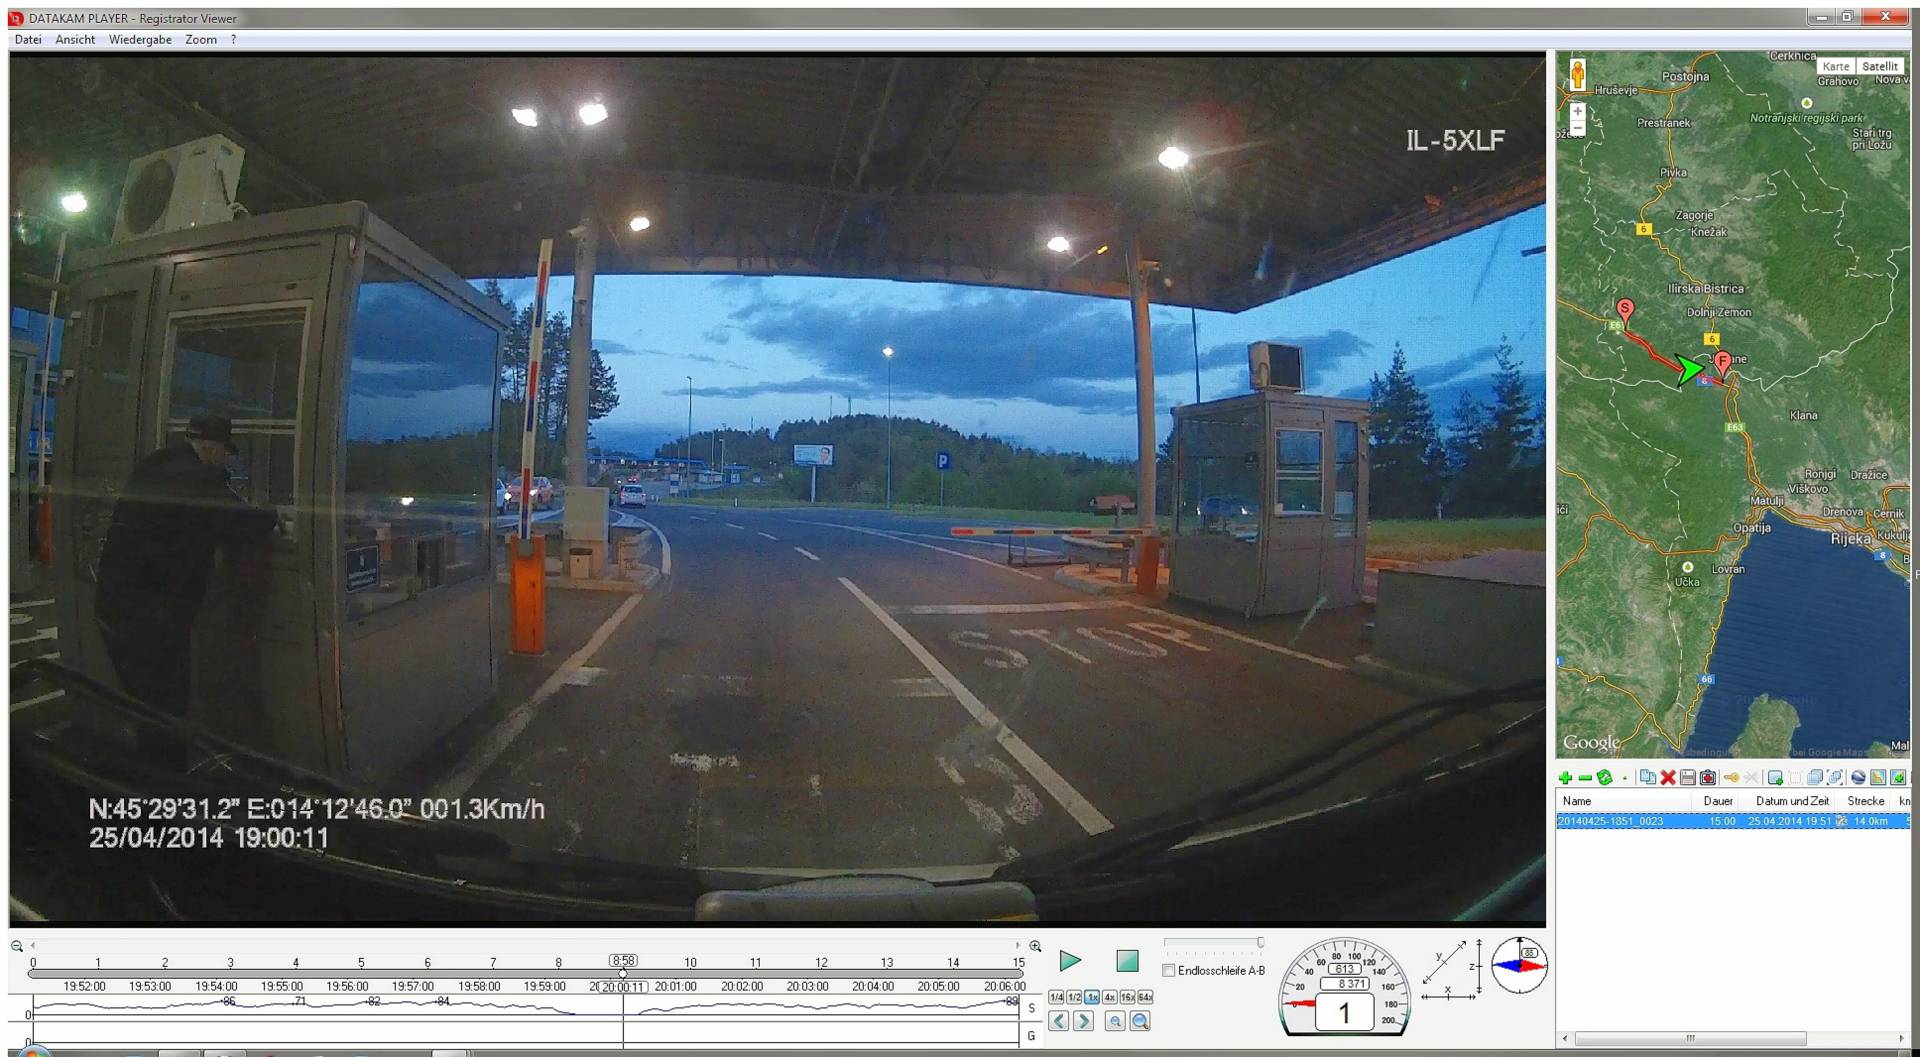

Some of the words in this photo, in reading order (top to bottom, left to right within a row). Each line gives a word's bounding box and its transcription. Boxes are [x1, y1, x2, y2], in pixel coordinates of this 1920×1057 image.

[29, 14, 84, 24] DATAKAM
[88, 14, 128, 24] PLAYER
[140, 13, 199, 26] Registrator
[201, 14, 237, 24] Viewer
[15, 35, 42, 45] Datei
[56, 35, 95, 45] Ansicht
[109, 35, 172, 47] Wiedergabe
[185, 35, 217, 45] Zoom
[231, 35, 236, 45] ?
[1770, 51, 1817, 61] Cerknica
[1823, 62, 1850, 71] Karte
[1863, 61, 1899, 71] Satellit
[1662, 71, 1710, 83] Postojna
[1818, 77, 1859, 86] Grahovo
[1875, 76, 1901, 84] Nova
[1595, 84, 1638, 96] Hruševje
[1637, 118, 1691, 128] Prestranek
[1750, 113, 1800, 124] Notranjski
[1802, 113, 1839, 124] regijski
[1841, 114, 1863, 124] park
[1853, 128, 1875, 138] Stari
[1878, 129, 1892, 140] trg
[1853, 140, 1865, 151] pri
[1868, 139, 1892, 149] Ložu
[1660, 168, 1687, 178] Pivka
[1676, 210, 1714, 221] Zagorje
[1641, 226, 1647, 234] 6
[1691, 226, 1727, 237] Knežak
[1668, 284, 1701, 294] Ilirska
[1704, 284, 1744, 294] Bistrica
[1621, 303, 1629, 313] S
[1687, 307, 1715, 318] Dolnji
[1718, 308, 1752, 317] Zemon
[1720, 359, 1726, 367] F
[1790, 410, 1818, 421] Klana
[1727, 423, 1743, 432] E63
[939, 454, 948, 468] P
[1805, 469, 1837, 481] Ronjgi
[1851, 469, 1888, 480] Dražice
[1788, 484, 1828, 495] Viškovo
[1751, 496, 1784, 508] Matulji
[1823, 508, 1863, 517] Drenova
[1734, 523, 1772, 535] Opatija
[1831, 532, 1871, 548] Rijeka
[1712, 565, 1745, 574] Lovran
[1675, 576, 1700, 588] Učka
[949, 622, 1211, 668] STOP
[1564, 735, 1620, 753] Google
[1563, 796, 1592, 806] Name
[1704, 796, 1733, 806] Dauer
[1756, 796, 1788, 806] Datum
[1791, 796, 1809, 806] und
[1810, 796, 1830, 806] Zeit
[1848, 796, 1885, 806] Strecke
[1557, 816, 1664, 828] 20140425-1851_0023
[1748, 816, 1802, 826] 25.04.2014
[30, 957, 37, 968] 0
[96, 957, 100, 968] 1
[162, 957, 169, 968] 2
[228, 957, 234, 968] 3
[293, 957, 300, 968] 4
[358, 957, 365, 968] 5
[424, 957, 431, 968] 6
[490, 957, 497, 968] 7
[555, 957, 562, 968] 8
[613, 955, 635, 966] 8:58
[685, 957, 697, 968] 10
[750, 957, 761, 968] 11
[816, 957, 828, 968] 12
[881, 957, 894, 968] 13
[948, 957, 960, 968] 14
[1013, 957, 1026, 968] 15
[1178, 965, 1247, 976] Endlosschleife
[1248, 965, 1266, 976] A-B
[1305, 968, 1314, 976] 40
[1335, 965, 1354, 973] 613
[1373, 968, 1386, 976] 140
[64, 981, 106, 992] 19:52:00
[129, 981, 171, 992] 19:53:00
[196, 981, 238, 992] 19:54:00
[261, 981, 303, 992] 19:55:00
[327, 981, 369, 992] 19:56:00
[392, 981, 434, 992] 19:57:00
[459, 981, 501, 992] 19:58:00
[524, 981, 566, 992] 19:59:00
[602, 983, 643, 993] 20:00:11
[655, 981, 697, 992] 20:01:00
[721, 981, 764, 992] 20:02:00
[787, 981, 829, 992] 20:03:00
[852, 981, 895, 992] 20:04:00
[918, 981, 960, 992] 20:05:00
[985, 981, 1026, 992] 20:06:00
[1051, 993, 1063, 1001] 1/4
[1069, 993, 1081, 1001] 1/2
[1088, 993, 1098, 1001] 1x
[1105, 993, 1115, 1001] 4x
[1028, 1002, 1035, 1014] S
[1340, 1002, 1348, 1024] 1
[25, 1010, 31, 1020] 0
[1027, 1030, 1036, 1041] G
